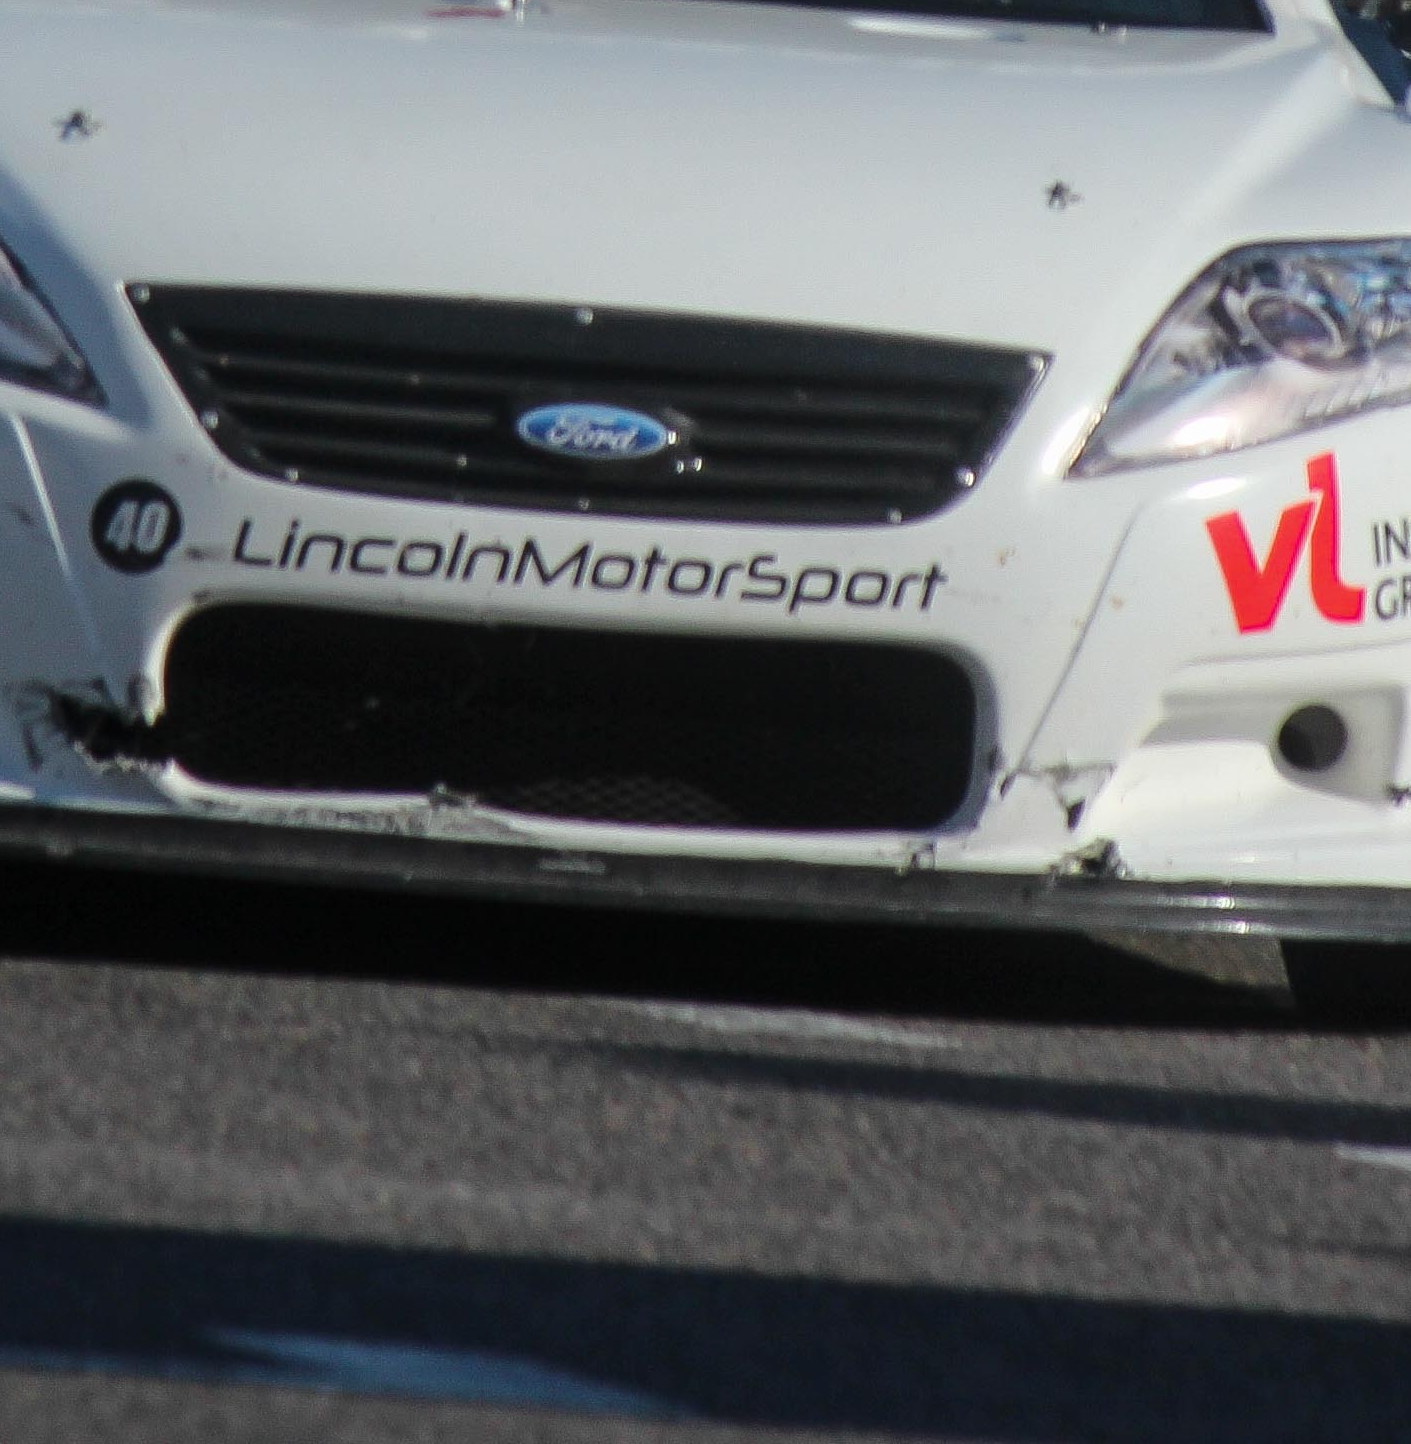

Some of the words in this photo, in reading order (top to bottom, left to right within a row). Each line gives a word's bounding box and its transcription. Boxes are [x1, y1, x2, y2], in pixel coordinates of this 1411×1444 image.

[545, 411, 641, 452] Ford
[104, 499, 170, 554] 40
[232, 518, 947, 615] LincolnMotorSport
